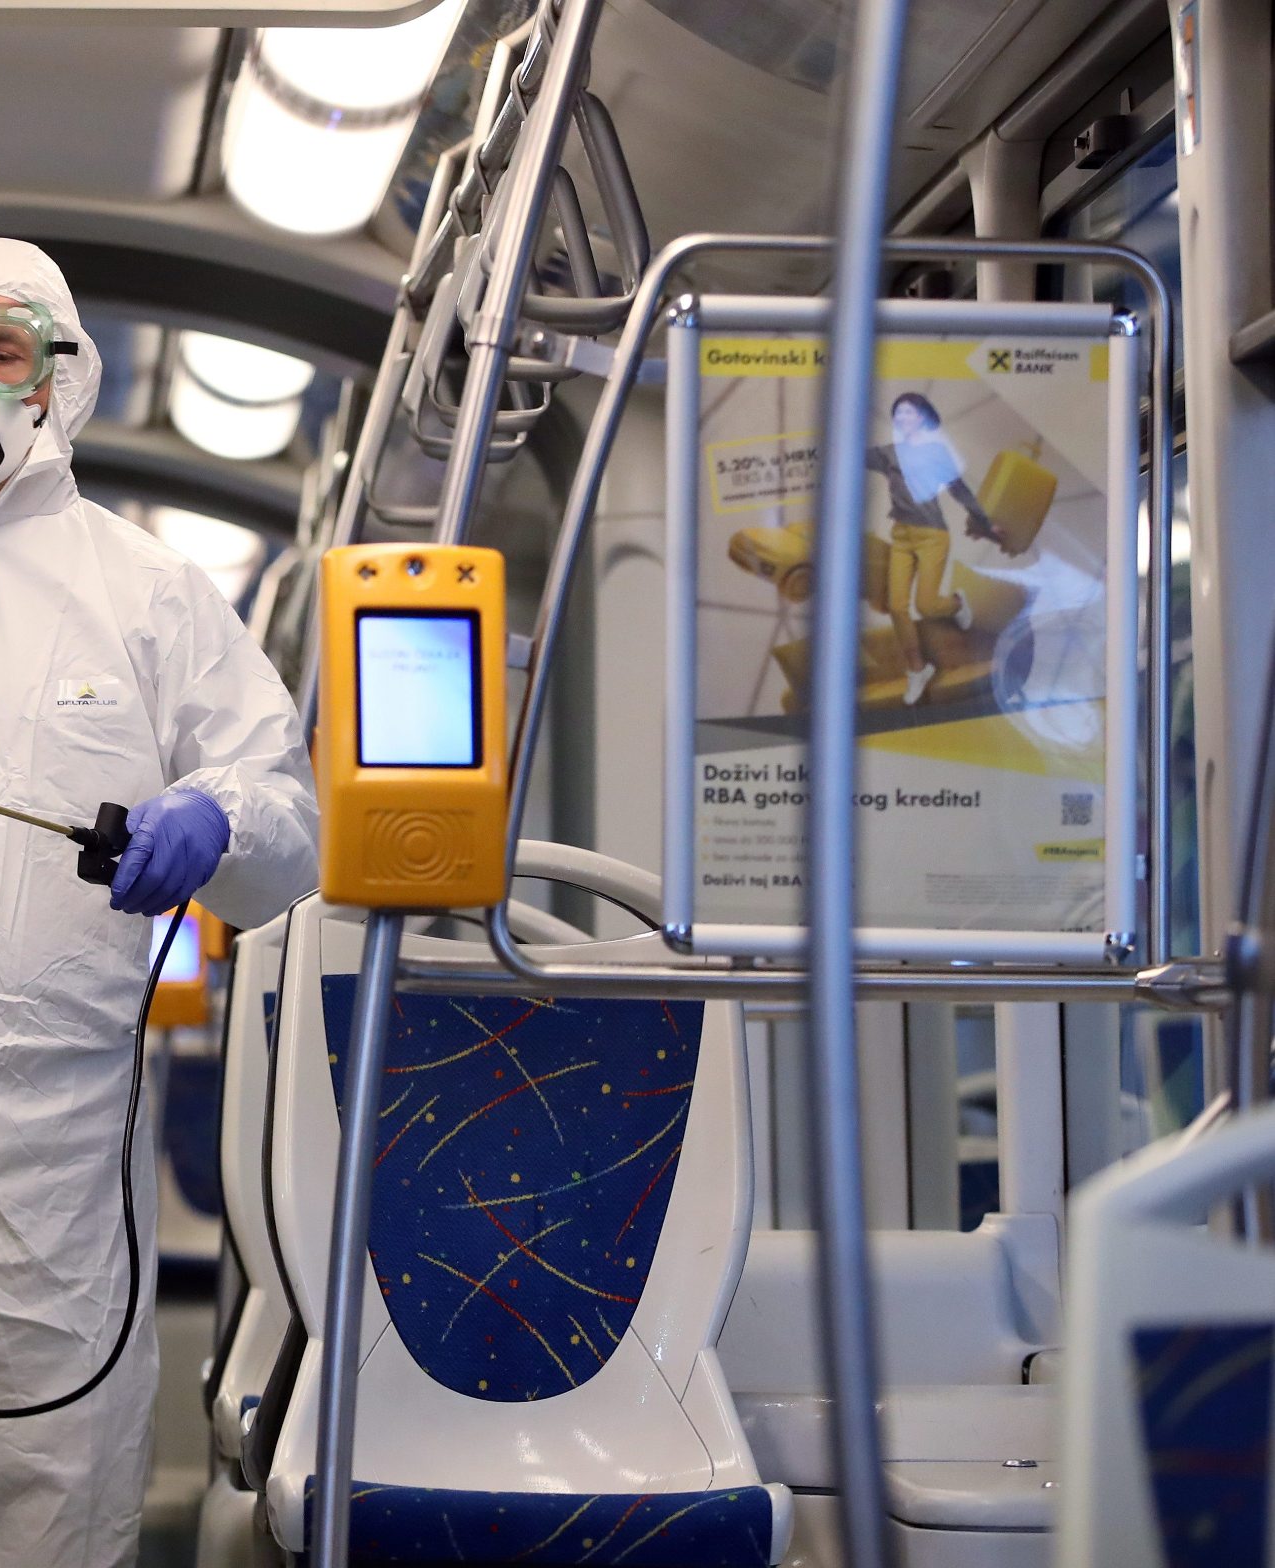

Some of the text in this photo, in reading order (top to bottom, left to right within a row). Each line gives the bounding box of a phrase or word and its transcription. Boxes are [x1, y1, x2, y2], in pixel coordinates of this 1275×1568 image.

[708, 349, 806, 366] Gotovinski
[704, 764, 769, 782] Doživi
[704, 787, 747, 805] RBA
[895, 786, 980, 808] kredita!
